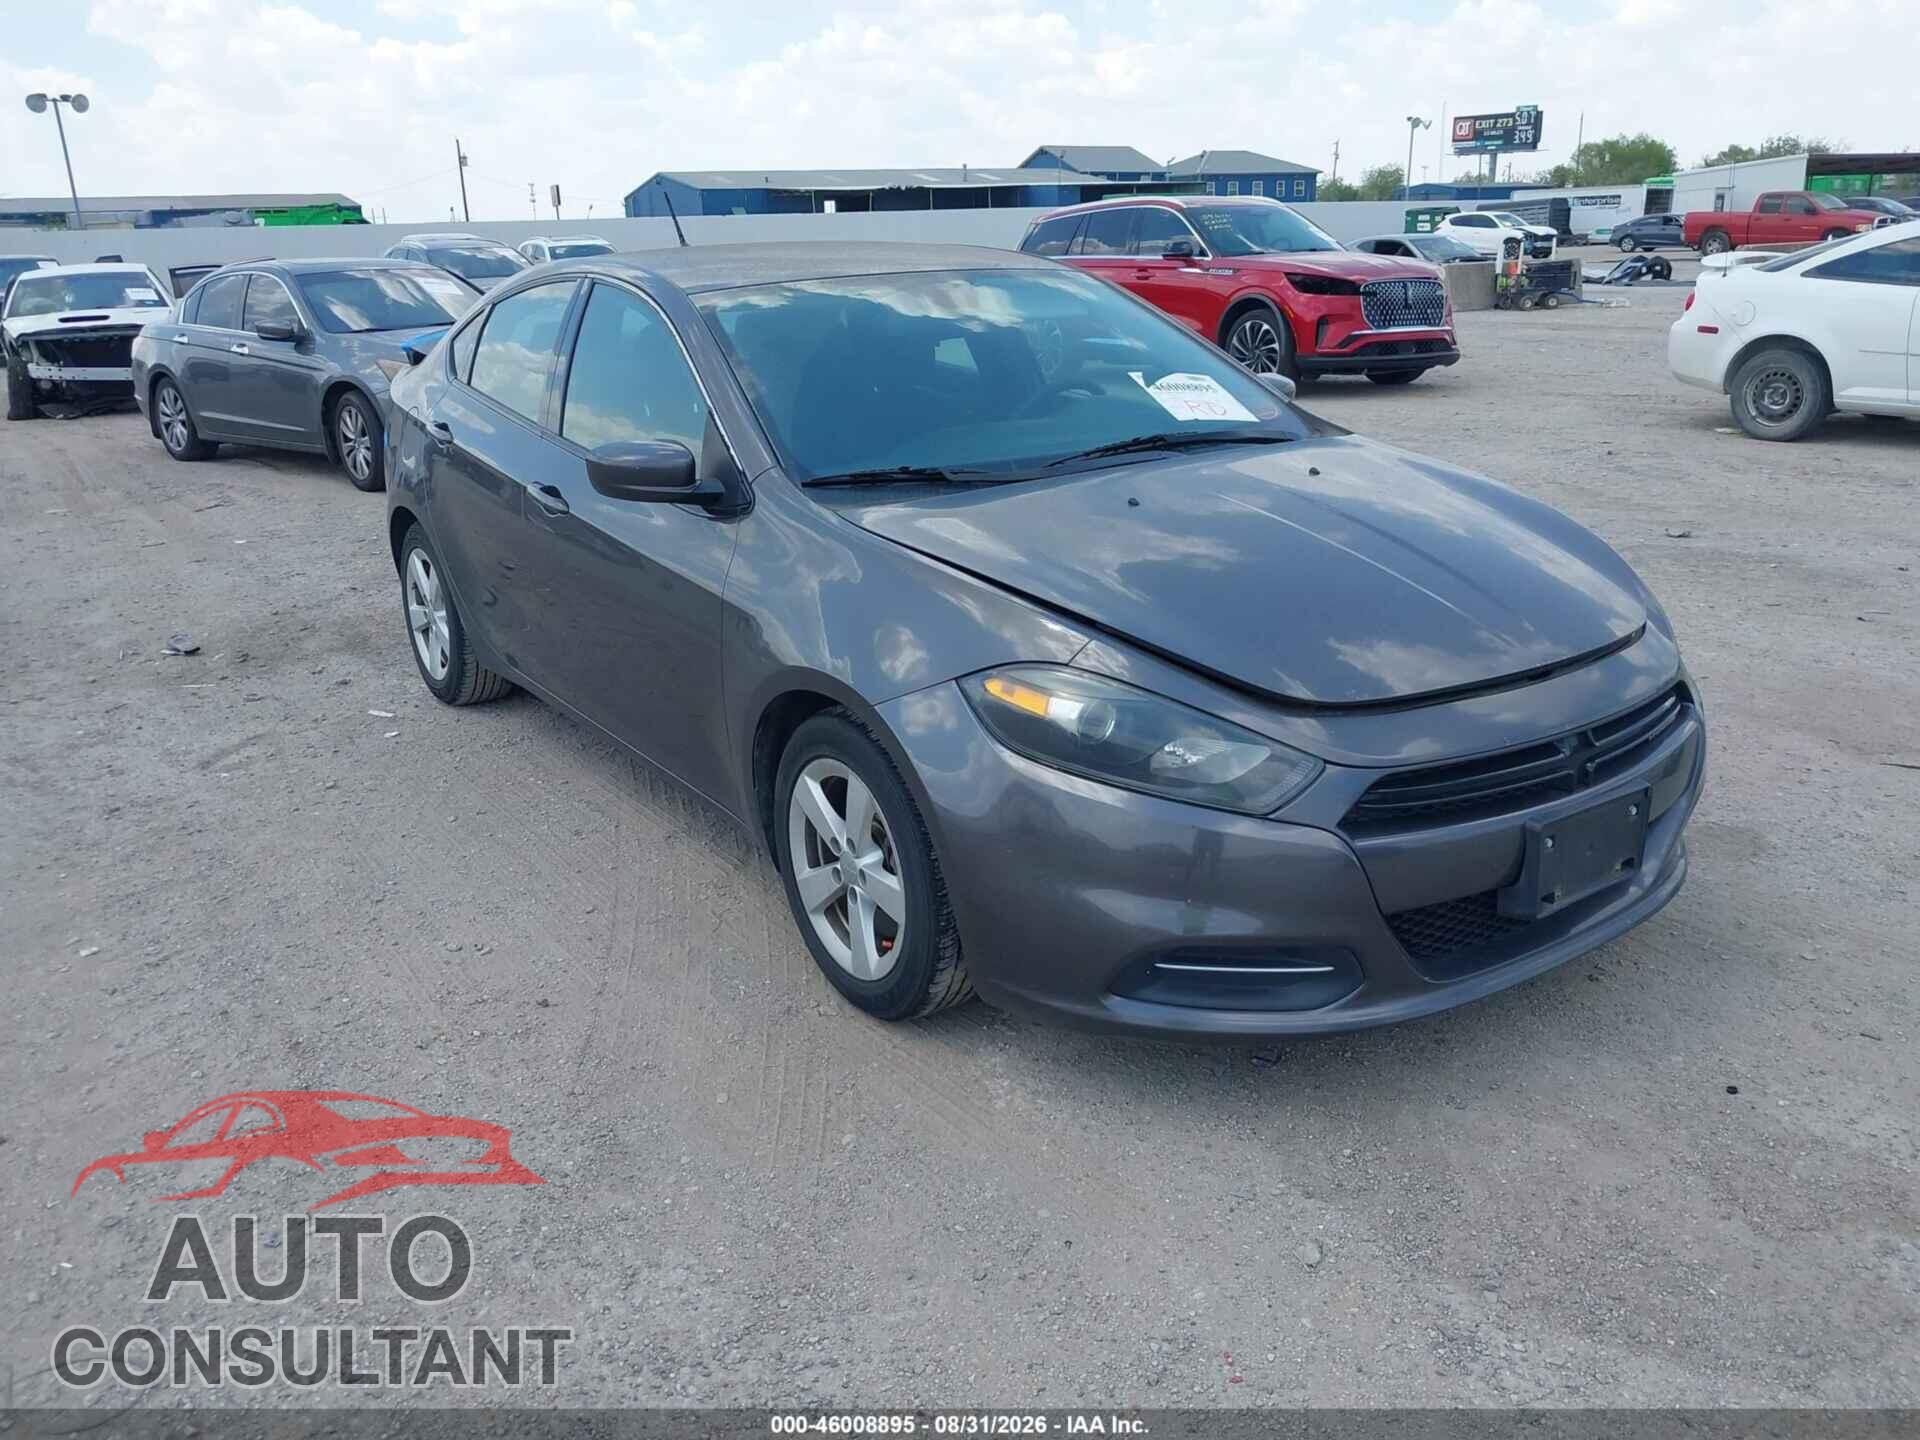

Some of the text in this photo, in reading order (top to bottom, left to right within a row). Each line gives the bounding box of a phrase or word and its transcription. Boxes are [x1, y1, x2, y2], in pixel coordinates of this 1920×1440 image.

[1456, 121, 1470, 137] QT
[1475, 119, 1495, 129] EXIT
[1496, 117, 1513, 128] 273
